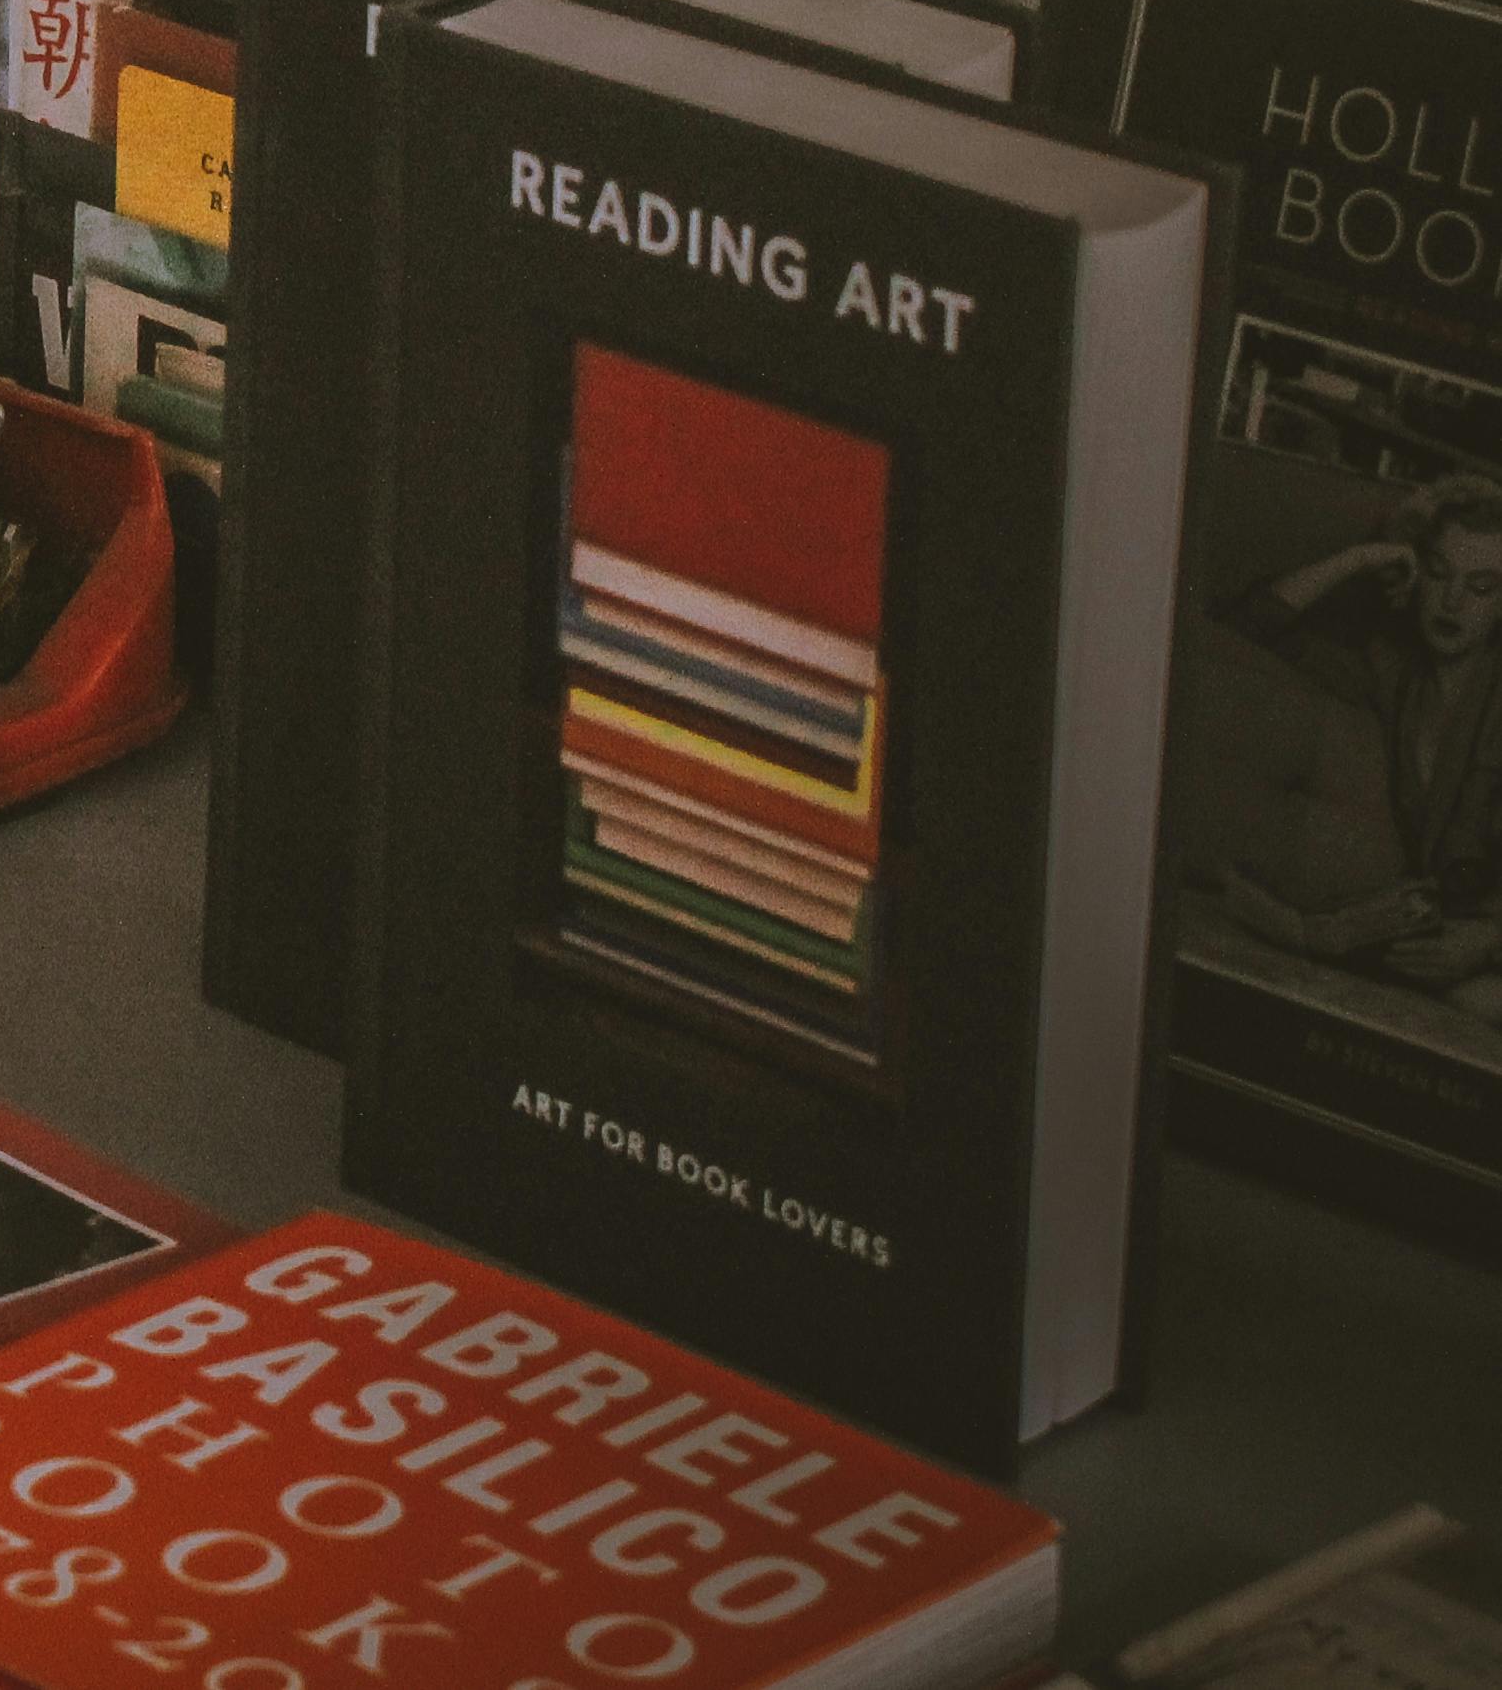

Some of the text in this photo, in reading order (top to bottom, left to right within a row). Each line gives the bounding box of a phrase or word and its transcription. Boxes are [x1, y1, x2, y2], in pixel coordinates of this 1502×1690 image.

[1263, 66, 1496, 198] HOLL
[1276, 168, 1502, 300] BOO
[509, 148, 977, 356] READING ART
[512, 1081, 893, 1270] ART FOR BOOK LOVERS
[111, 1295, 831, 1630] BASILICO
[242, 1244, 961, 1572] GABRIELE
[1, 1352, 698, 1682] PHOTO
